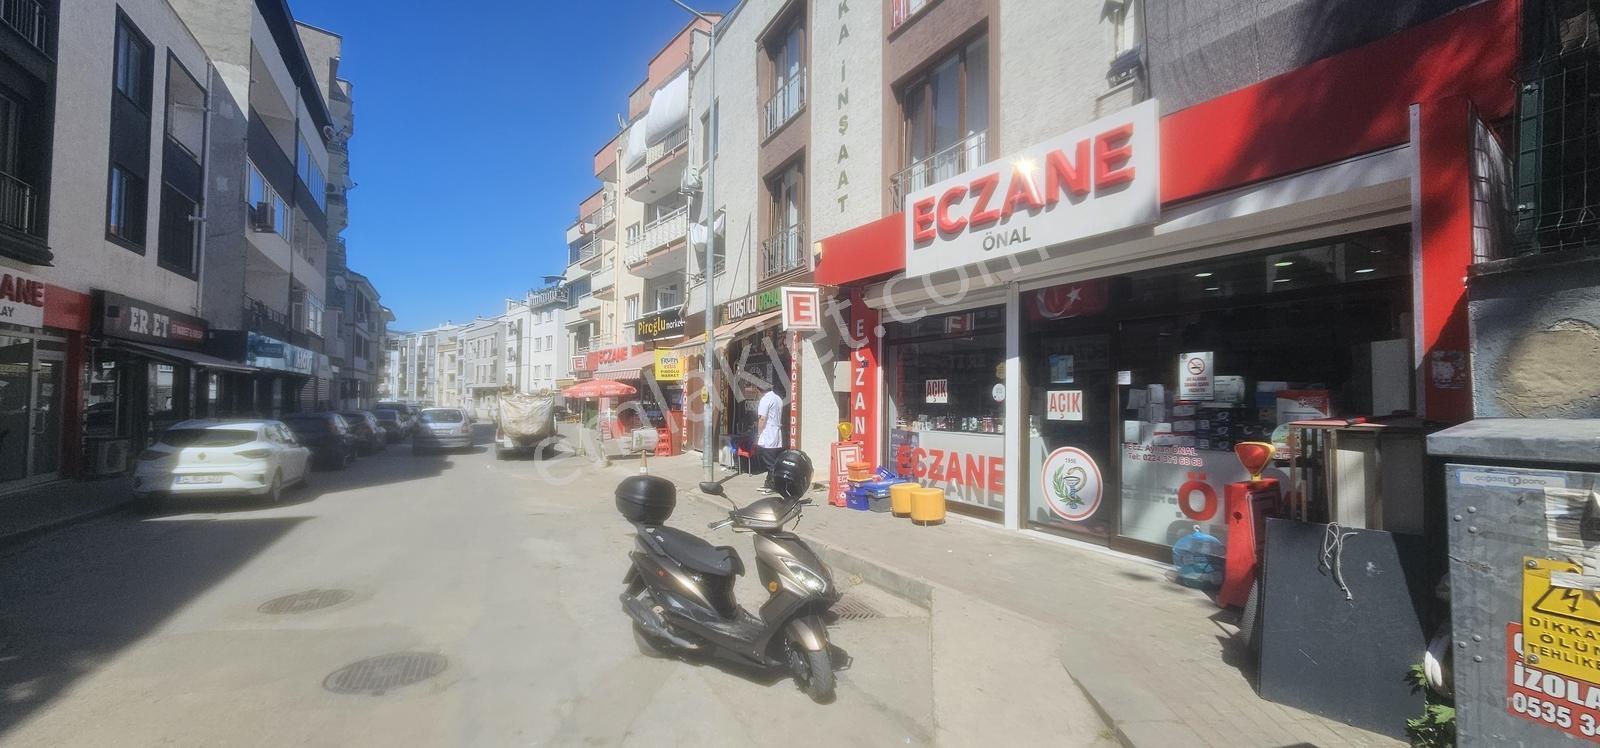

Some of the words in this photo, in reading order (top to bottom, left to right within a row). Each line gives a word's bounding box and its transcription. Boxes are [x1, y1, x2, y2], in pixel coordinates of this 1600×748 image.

[837, 60, 849, 213] İNŞAAT
[913, 122, 1136, 244] ECZANE
[982, 225, 1032, 251] ÖNAL
[0, 306, 14, 317] AY
[793, 296, 812, 321] E
[129, 306, 148, 334] ER
[152, 313, 169, 338] ET
[638, 316, 666, 336] Piroğlu
[926, 381, 947, 403] AÇIK
[1049, 393, 1081, 419] AÇIK
[896, 443, 1005, 493] ECZANE
[1529, 616, 1600, 643] DİKKA
[1512, 692, 1572, 728] 0535
